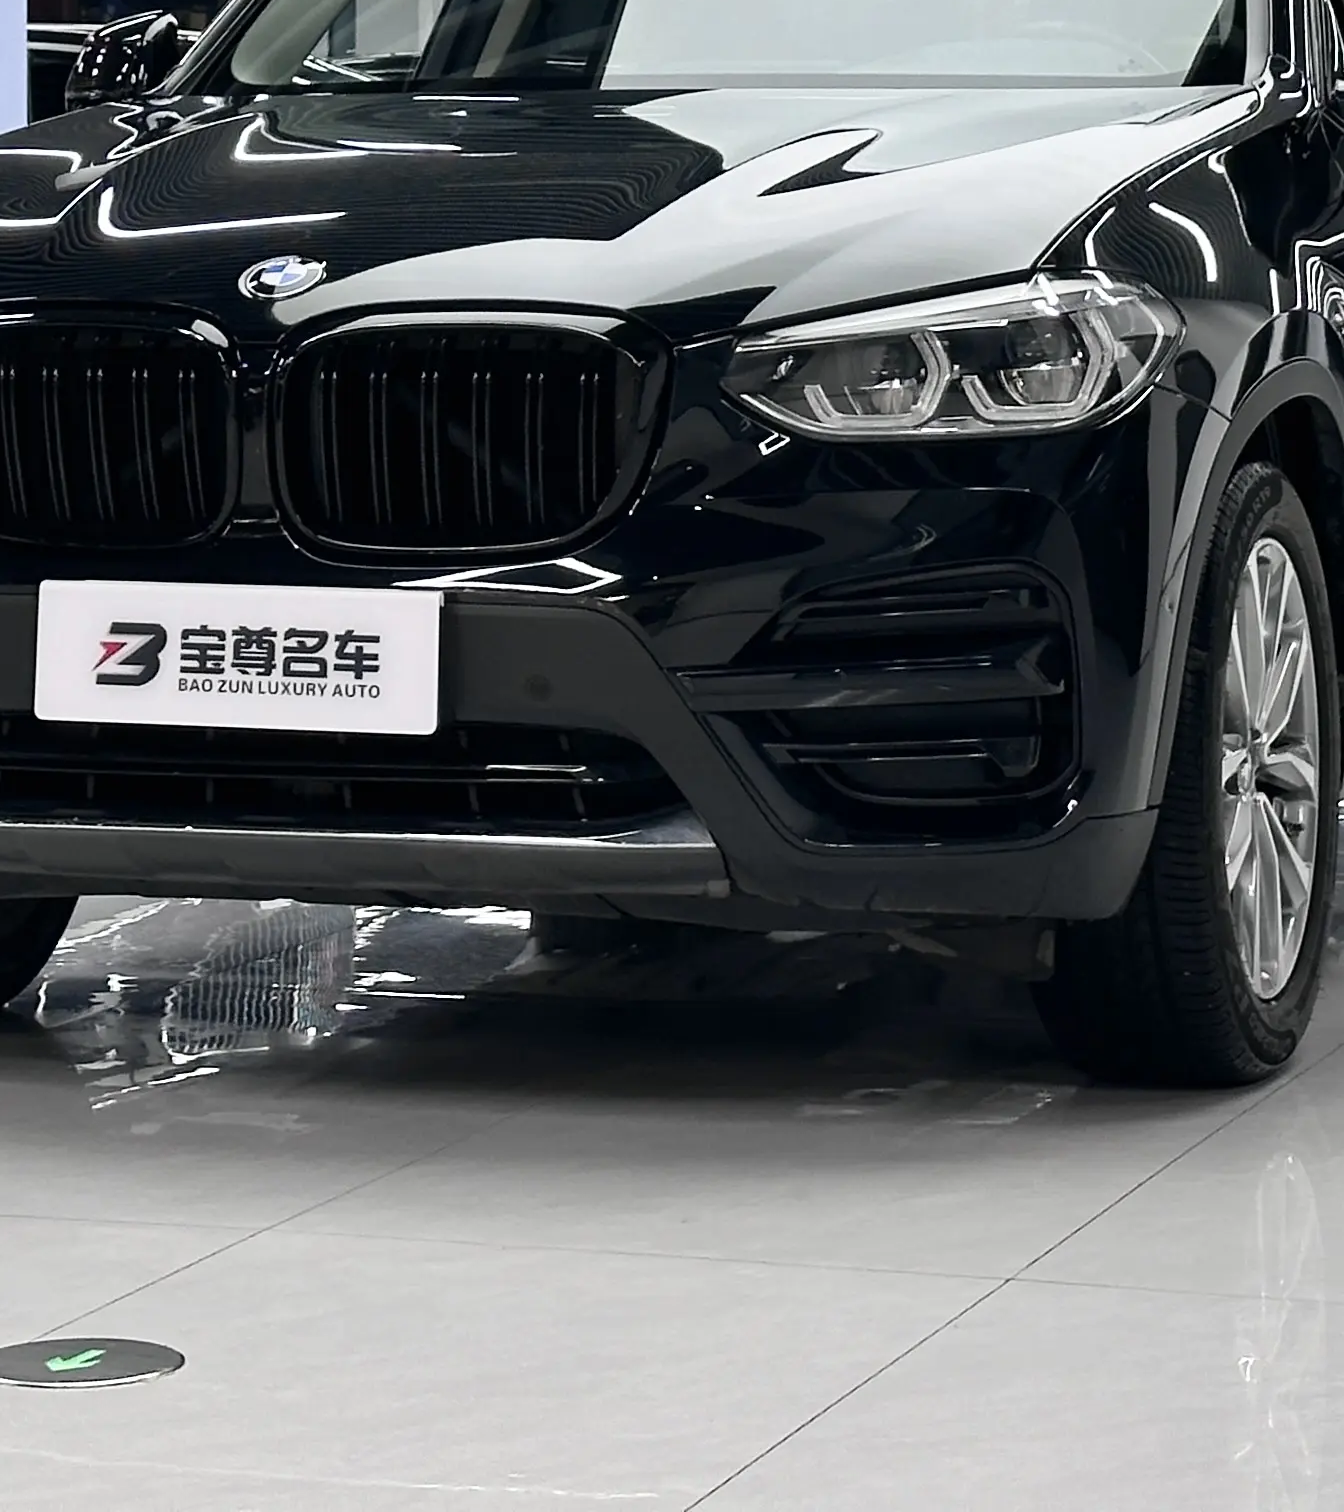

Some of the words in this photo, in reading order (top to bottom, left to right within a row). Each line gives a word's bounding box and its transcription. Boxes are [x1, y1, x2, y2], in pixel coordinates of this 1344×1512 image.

[180, 624, 381, 680] 宝尊名车
[178, 678, 213, 693] BAO
[217, 679, 253, 694] ZUN
[258, 680, 328, 697] LUXURY
[332, 684, 380, 699] AUTO
